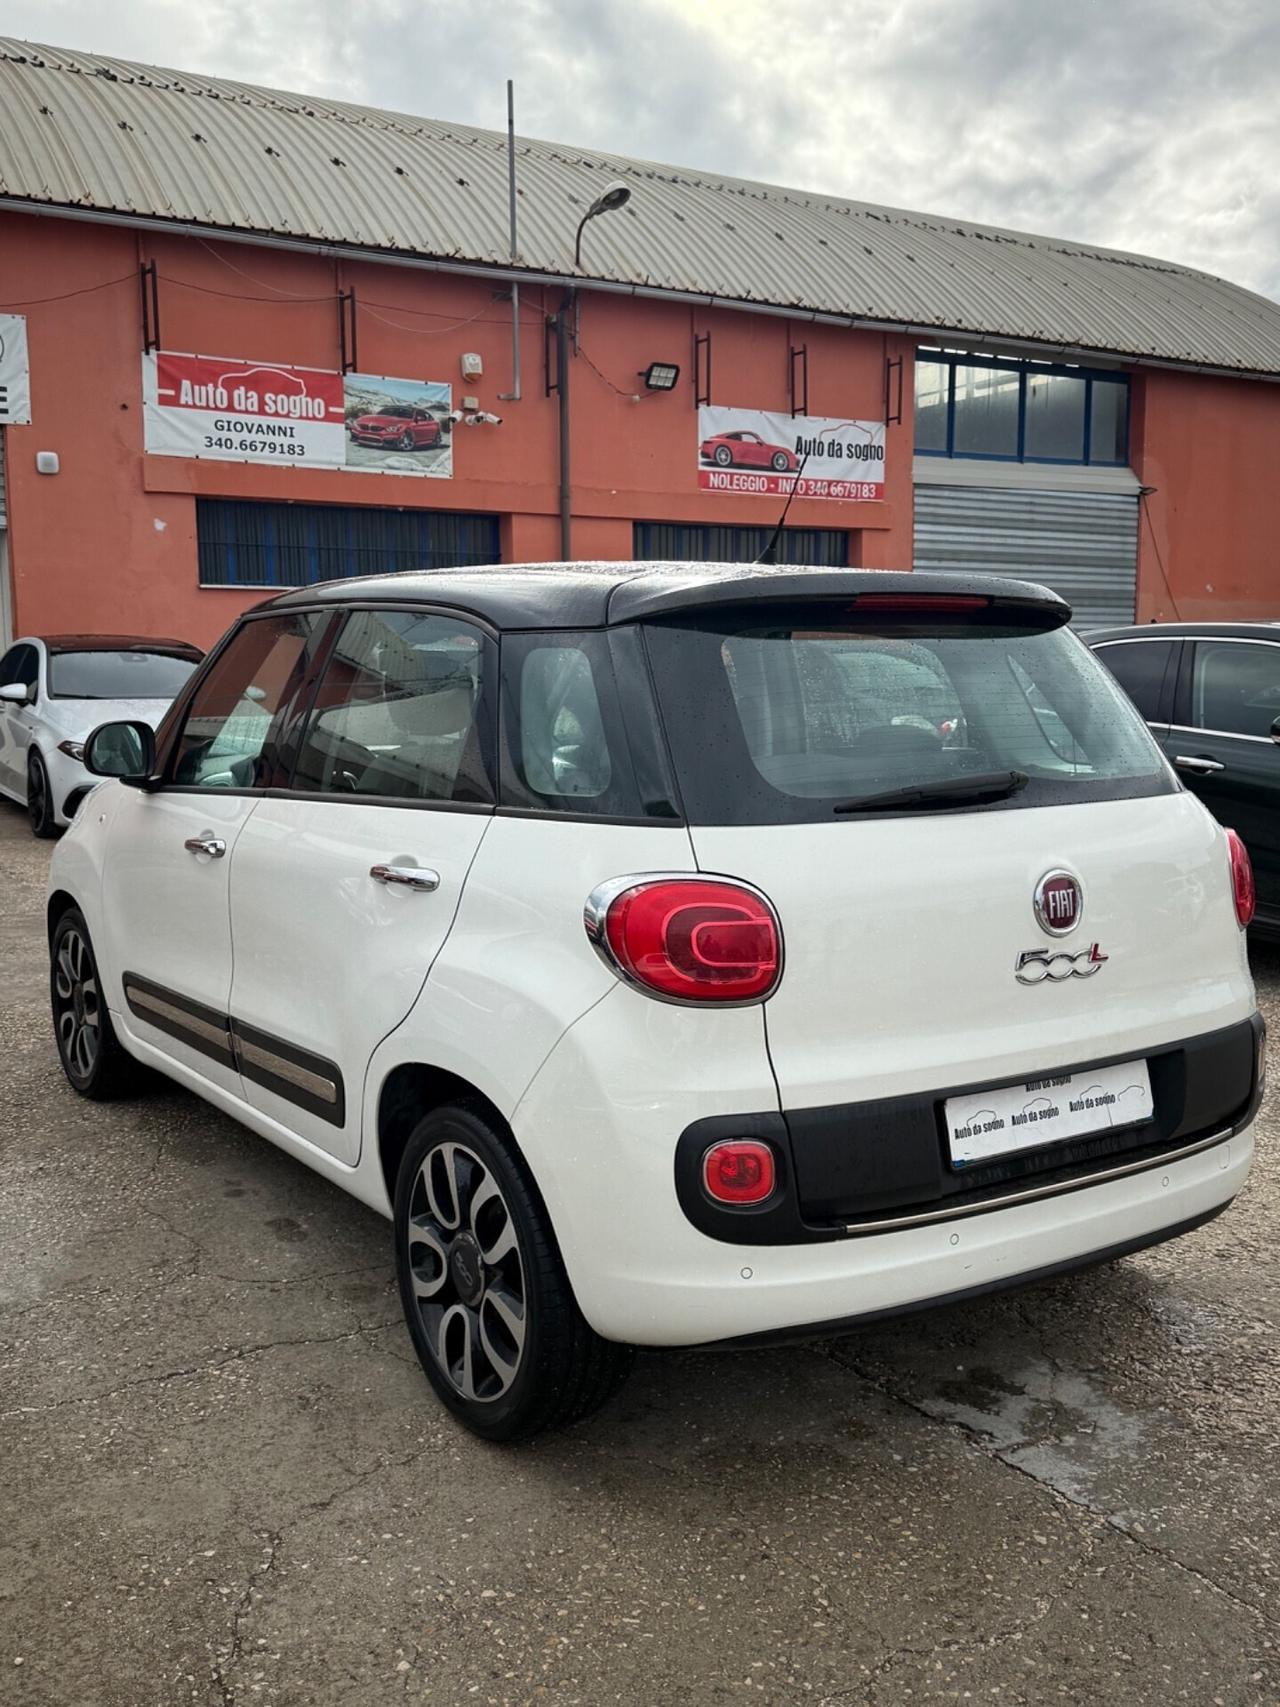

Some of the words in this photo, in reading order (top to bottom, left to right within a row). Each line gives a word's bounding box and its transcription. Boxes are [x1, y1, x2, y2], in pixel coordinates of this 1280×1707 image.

[179, 379, 228, 409] Auto
[233, 386, 259, 412] da
[264, 392, 325, 419] sogno
[214, 419, 296, 438] GIOVANNI
[204, 436, 305, 456] 340.6679183
[795, 436, 825, 457] Auto
[827, 439, 843, 459] da
[846, 443, 884, 462] sogno
[709, 473, 768, 492] NOLEGGIO
[808, 481, 828, 496] 340
[830, 483, 876, 498] 6679183
[1048, 888, 1074, 919] FIAT
[1015, 943, 1109, 986] 500L
[1069, 1100, 1085, 1112] Auto
[1085, 1098, 1094, 1109] da
[1011, 1113, 1028, 1126] Auto
[1029, 1111, 1038, 1122] da
[1039, 1107, 1060, 1119] sogno
[954, 1127, 972, 1140] Auto
[973, 1124, 982, 1135] da
